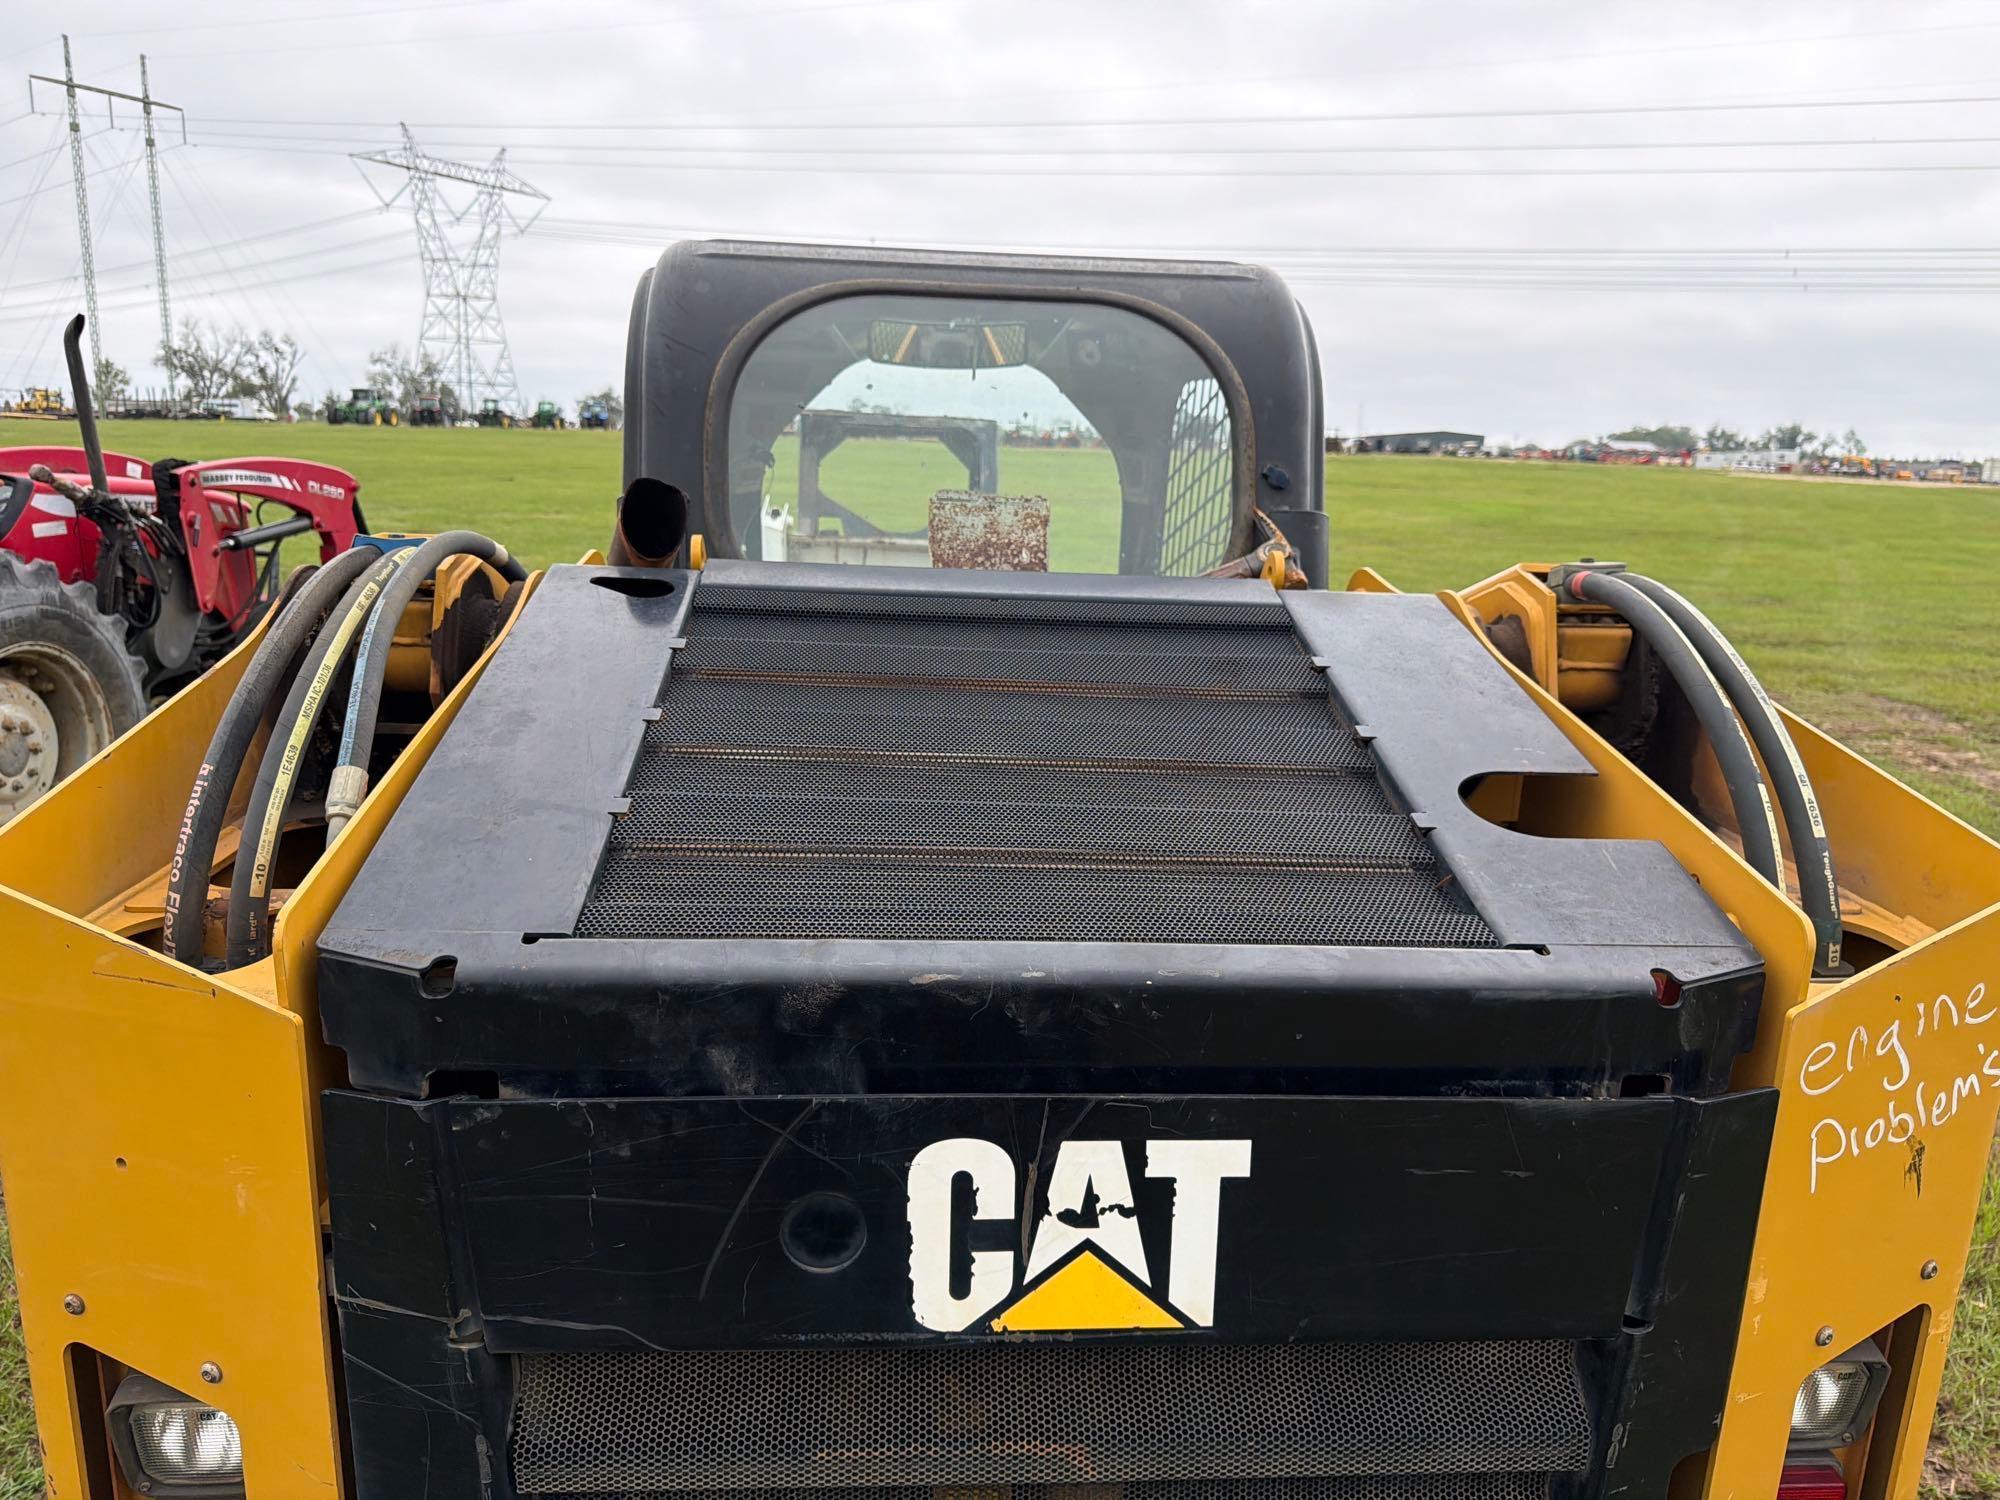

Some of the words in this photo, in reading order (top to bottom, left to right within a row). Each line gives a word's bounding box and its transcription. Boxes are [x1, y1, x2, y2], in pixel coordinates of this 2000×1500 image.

[202, 474, 233, 483] MASSEY
[235, 474, 272, 483] FERGUSON
[302, 696, 318, 720] MSHA
[170, 779, 208, 884] intertraco
[1800, 982, 1998, 1096] engine
[906, 1137, 1252, 1333] CAT
